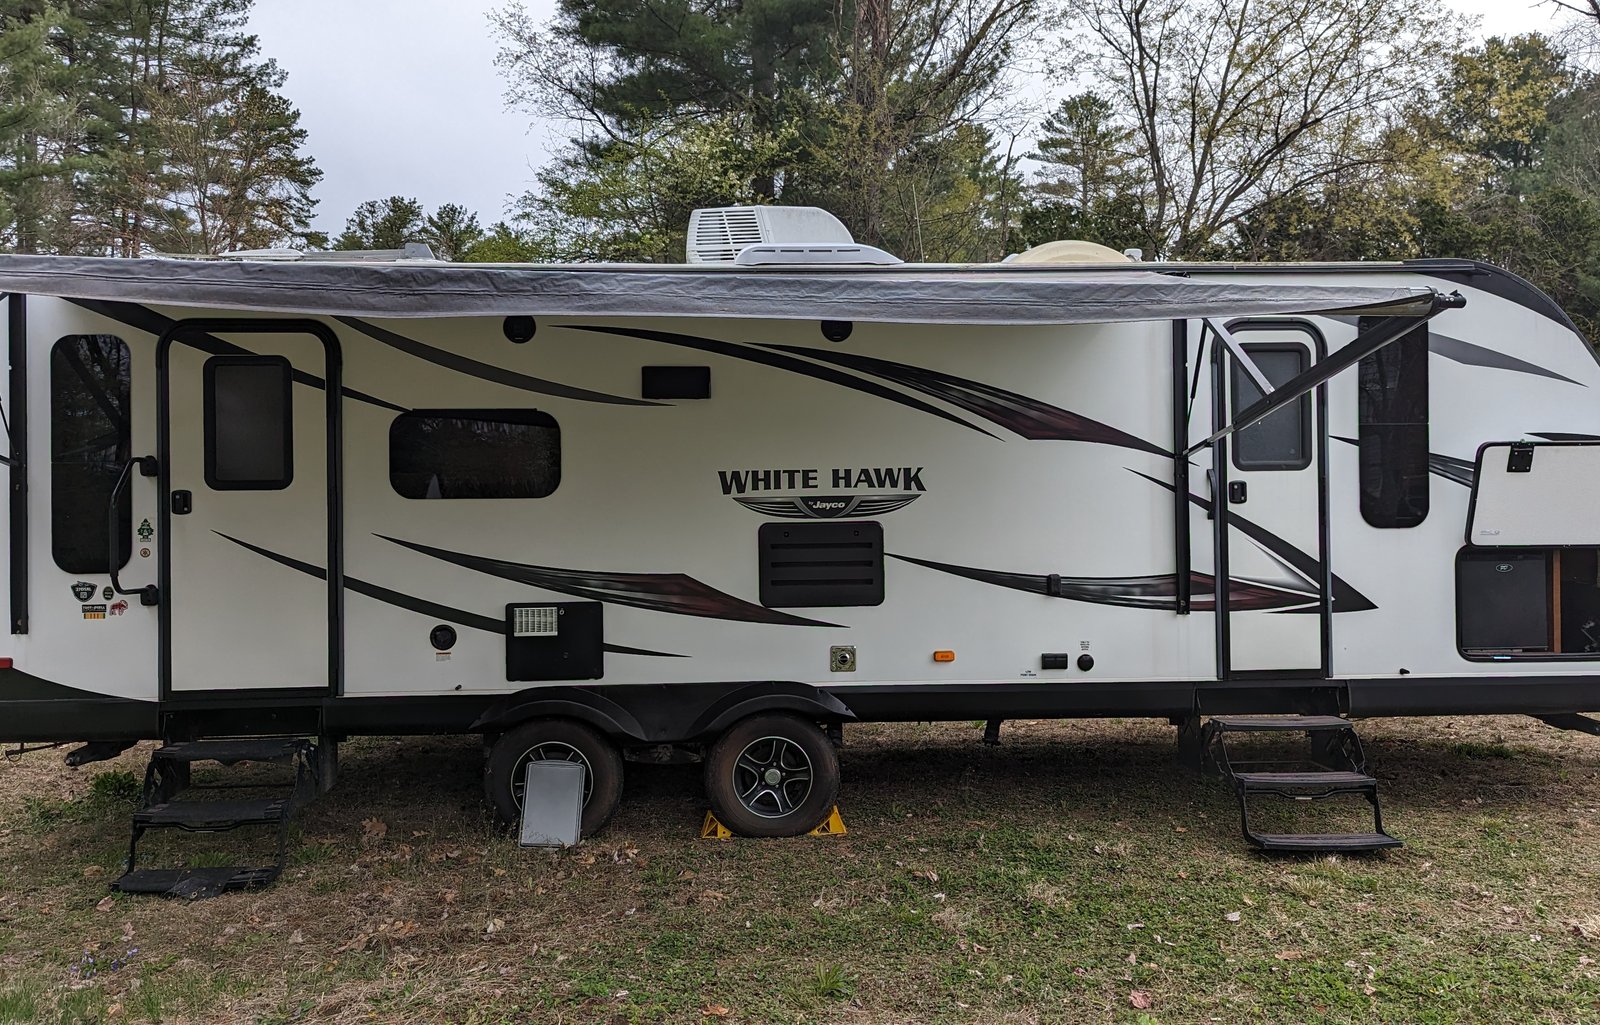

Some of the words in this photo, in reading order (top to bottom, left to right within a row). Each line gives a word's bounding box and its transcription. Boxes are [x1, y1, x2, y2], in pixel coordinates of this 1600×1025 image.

[717, 469, 818, 495] WHITE
[831, 467, 927, 492] HAWK
[812, 501, 846, 510] Jayco
